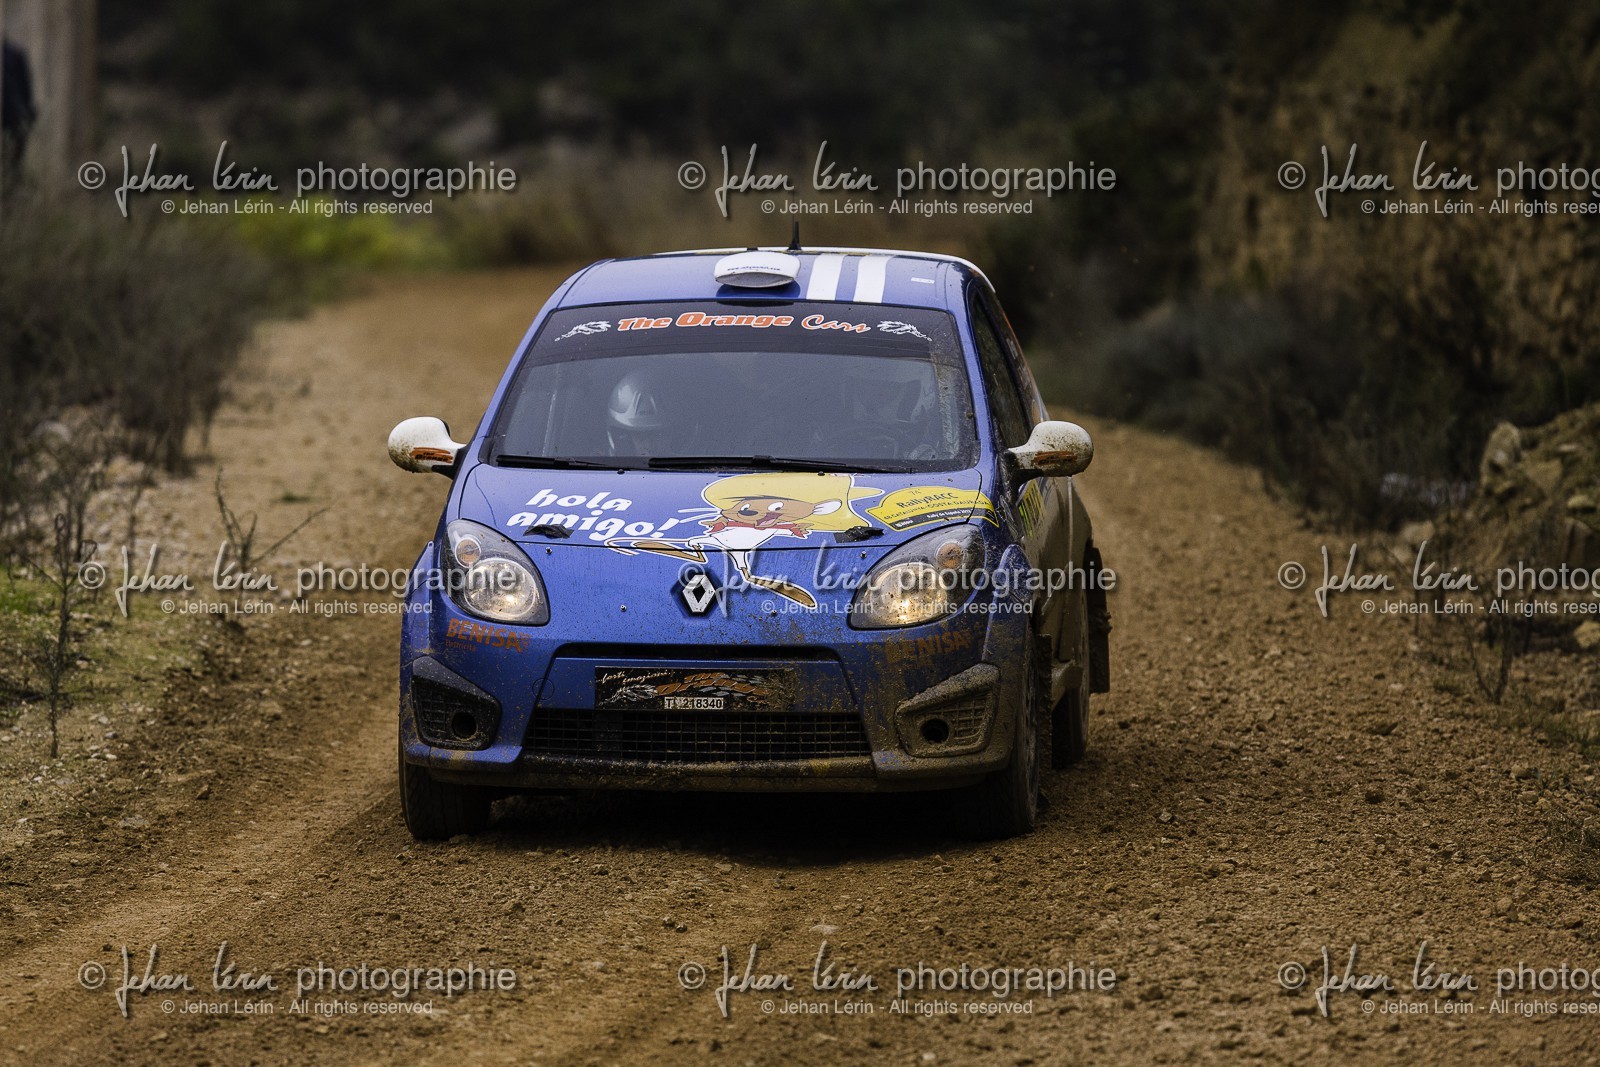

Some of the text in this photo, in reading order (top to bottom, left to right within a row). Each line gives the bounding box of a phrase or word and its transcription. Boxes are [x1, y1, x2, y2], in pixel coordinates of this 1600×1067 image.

[618, 312, 871, 333] The Orange Cars
[525, 488, 633, 511] hola
[895, 493, 959, 509] RallyRACC
[506, 509, 680, 541] amigo!
[445, 617, 524, 654] BENISA
